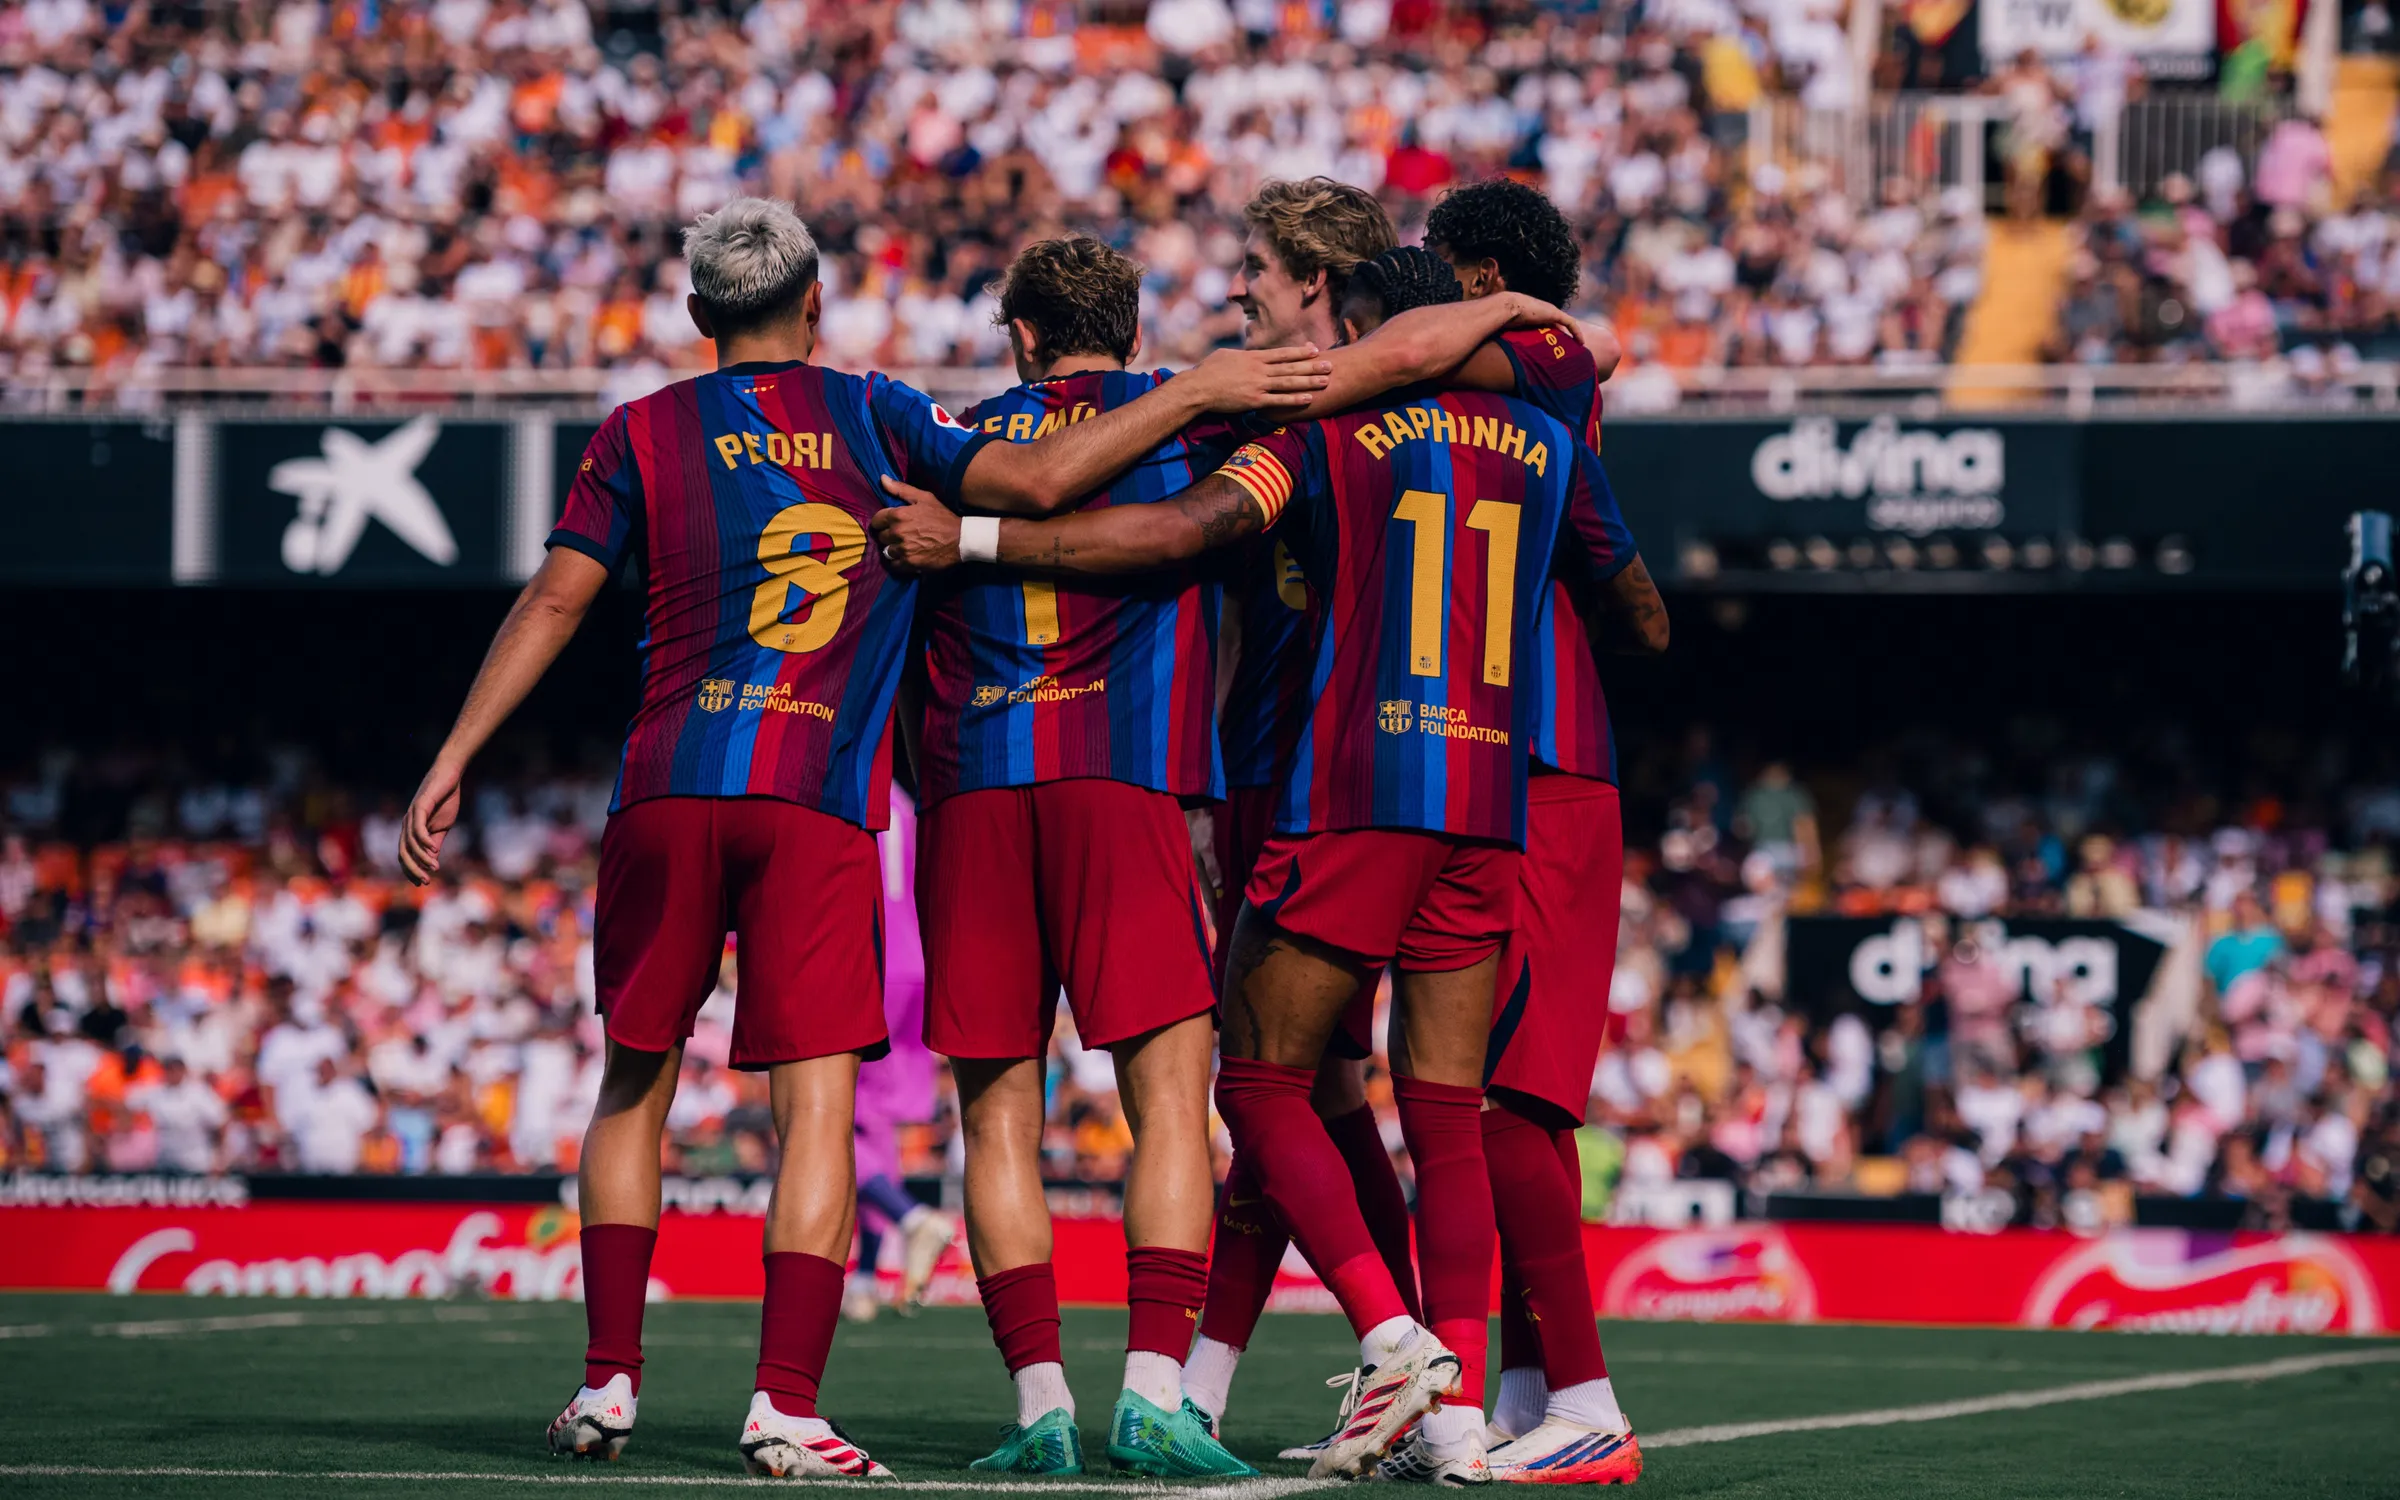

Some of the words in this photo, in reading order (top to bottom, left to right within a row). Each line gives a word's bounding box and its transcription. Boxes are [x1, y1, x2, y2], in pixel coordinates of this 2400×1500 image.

[972, 401, 1098, 440] ERMÍ
[1353, 406, 1548, 478] RAPHINHA
[713, 430, 833, 471] PEDRI
[1752, 416, 2006, 500] divina
[747, 502, 868, 654] 8
[1392, 488, 1523, 688] 11
[1419, 703, 1468, 725] BARÇA
[1419, 719, 1509, 746] FOUNDATION
